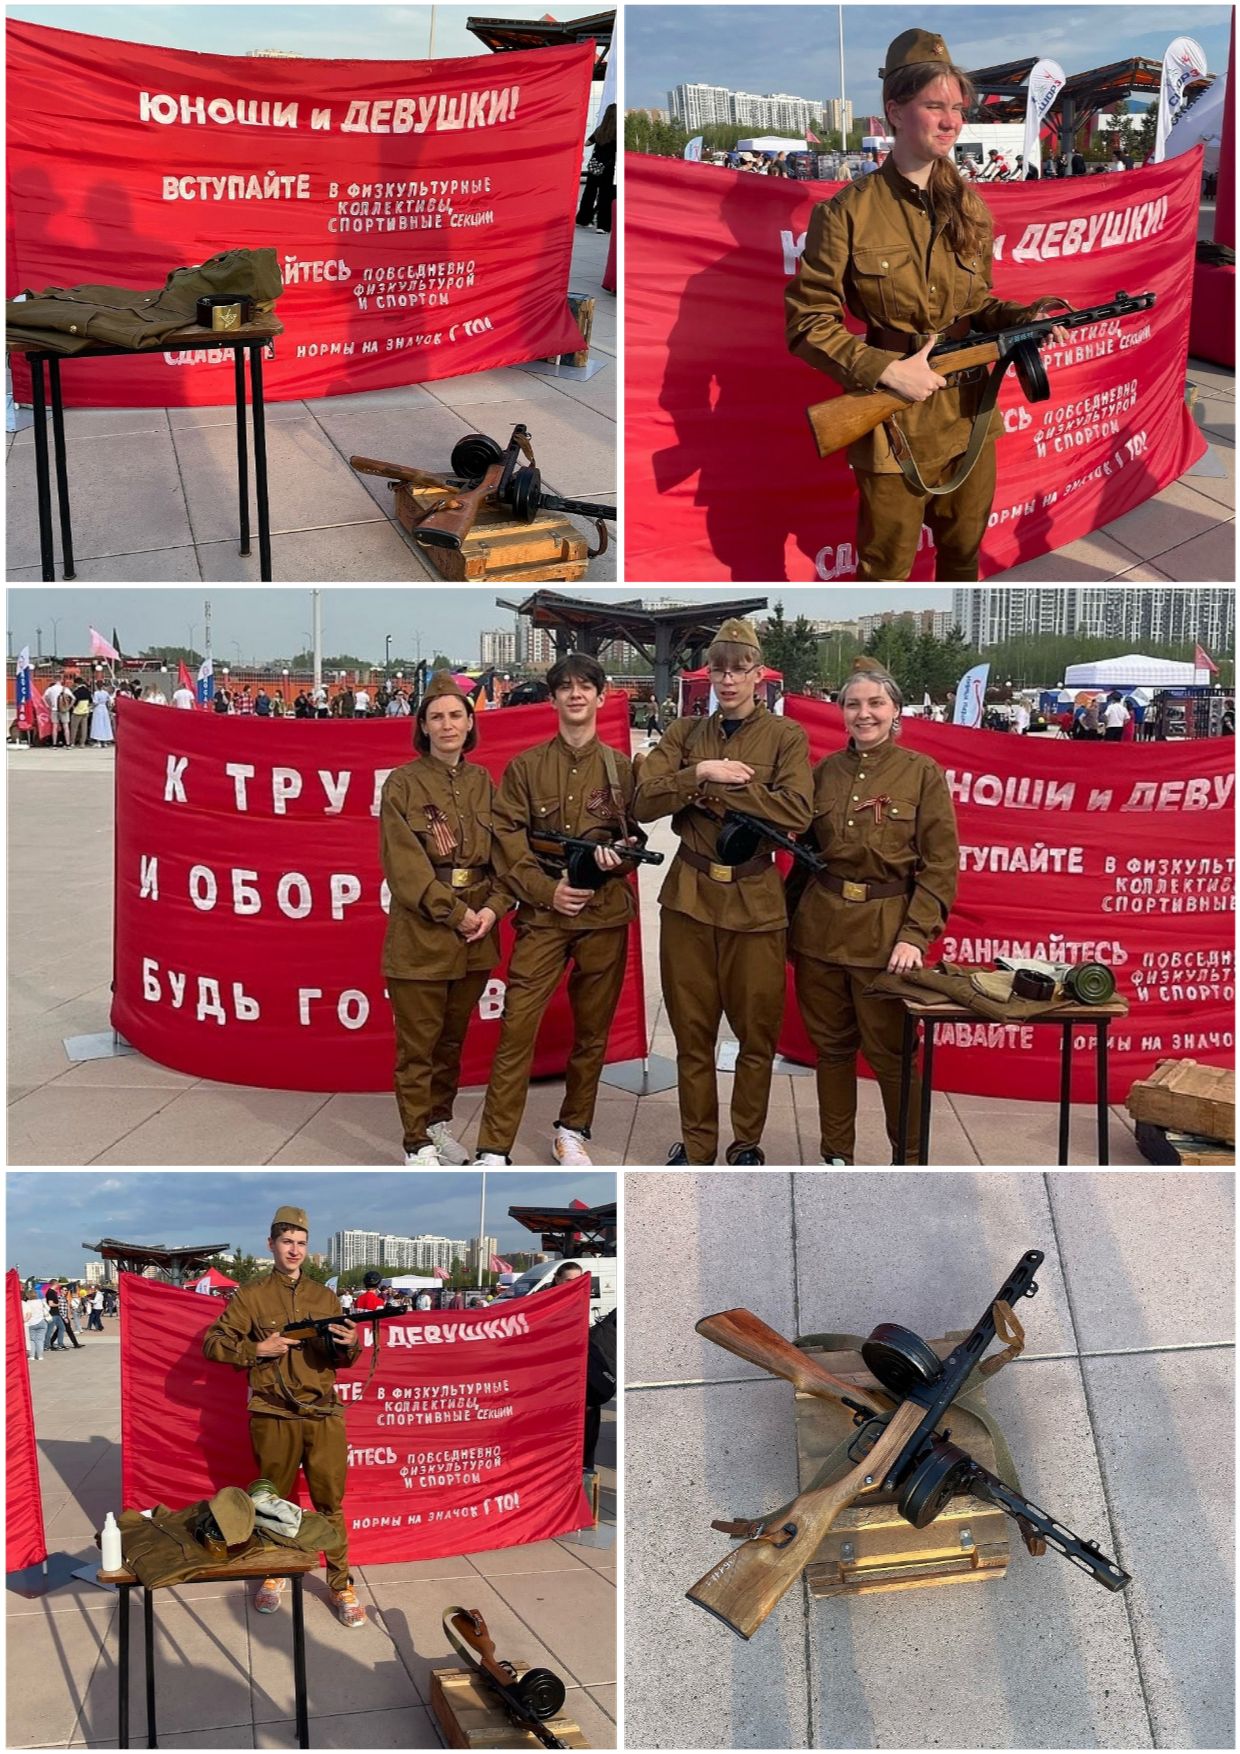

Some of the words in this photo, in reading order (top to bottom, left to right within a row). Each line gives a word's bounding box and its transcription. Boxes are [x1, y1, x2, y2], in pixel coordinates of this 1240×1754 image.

[139, 91, 299, 129] ЮНОШИ
[340, 86, 520, 134] ДЕВУШКИ!
[162, 170, 311, 201] ВСТУПАЙТЕ
[328, 182, 339, 199] В
[347, 177, 492, 199] ФИЗКУЛЬТУРНЫЕ
[328, 214, 442, 233] СПОРТИВНЫЕ
[450, 210, 494, 228] СЕКЦИИ
[1011, 195, 1168, 263] ДЕВУШКИ!
[353, 272, 475, 297] ФИЗКУЛЬТУРОЙ
[363, 260, 476, 281] ПОВСЕДНЕВНО
[358, 296, 368, 310] И
[376, 292, 449, 310] СПОРТОМ
[296, 341, 355, 358] НОРМЫ
[362, 339, 379, 353] НА
[386, 332, 443, 351] ЗНАЧОК
[1005, 338, 1114, 377] СРТИВНЫЕ
[1119, 324, 1151, 349] СЕКЦИИ
[1044, 379, 1138, 425] ПОВСЕДНЕВНО
[1033, 392, 1137, 444] ФИЗКУЛЬТУРОЙ
[1054, 419, 1120, 453] СПОРТОМ
[987, 499, 1036, 528] ОРМЫ
[1042, 491, 1058, 508] НА
[164, 754, 189, 803] К
[225, 762, 399, 817] ТРУ
[945, 769, 1076, 811] НОШИ
[1120, 773, 1235, 812] ДЕВУ
[958, 842, 1084, 874] ТУПАЙТЕ
[1105, 856, 1116, 874] В
[1126, 857, 1235, 876] ФИЗКУЛЬТ
[139, 854, 159, 901] И
[189, 864, 392, 921] ОБОР
[1116, 877, 1235, 894] КОЛЛЕКТИВ
[942, 933, 1128, 966] ЗАНИМАЙТЕСЬ
[1142, 950, 1234, 969] ПОВСЕДН
[1131, 968, 1234, 987] ФИЗКУЛЬТ
[1137, 986, 1149, 1002] И
[1159, 984, 1234, 1002] СПОРТО
[143, 957, 260, 1026] БУДЬ
[298, 978, 506, 1030] ГОВ
[919, 1019, 1034, 1049] АВАЙТЕ
[1141, 1035, 1162, 1051] НА
[1172, 1032, 1233, 1050] ЗНАЧО
[386, 1313, 530, 1348] ДЕВУШКИ!
[377, 1387, 386, 1400] В
[392, 1379, 510, 1400] ФИЗКУЛЬТУРНЫЕ
[376, 1409, 471, 1426] СПОРТИВНЫЕ
[477, 1405, 513, 1420] СЕКЦИИ
[400, 1456, 501, 1478] ФИЗКУЛЬТУРОЙ
[407, 1445, 501, 1465] ПОВСЕДНЕВНО
[420, 1472, 481, 1489] СПОРТОМ
[352, 1515, 401, 1529] НОРМЫ
[408, 1515, 421, 1525] НА
[428, 1506, 479, 1522] ЗНАЧОК
